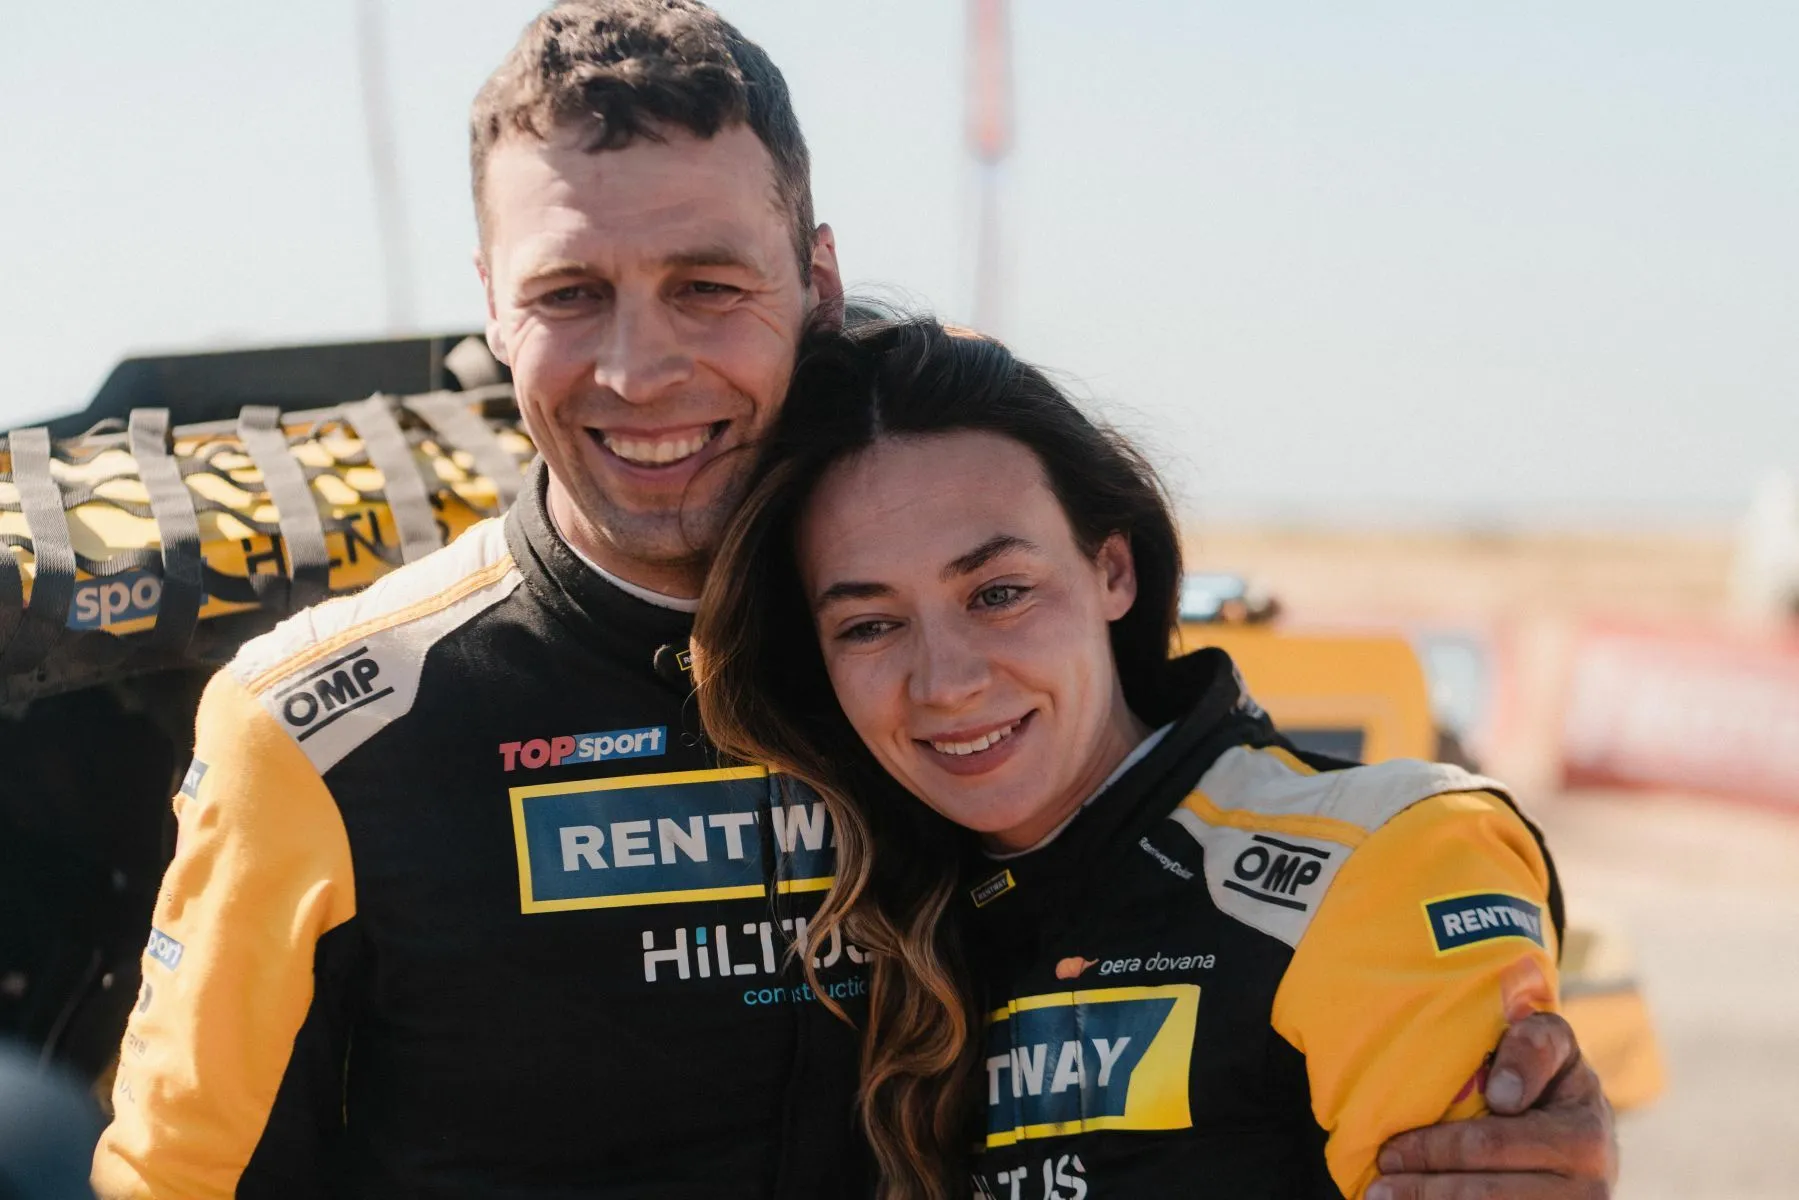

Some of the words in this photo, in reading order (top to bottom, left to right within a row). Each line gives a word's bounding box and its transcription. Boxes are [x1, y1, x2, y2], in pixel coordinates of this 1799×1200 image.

[76, 576, 161, 626] spo
[283, 658, 380, 728] OMP
[559, 802, 836, 872] RENTW
[1234, 846, 1322, 896] OMP
[1098, 957, 1142, 977] gera
[1144, 951, 1217, 972] dovana
[985, 1036, 1132, 1107] TWAY
